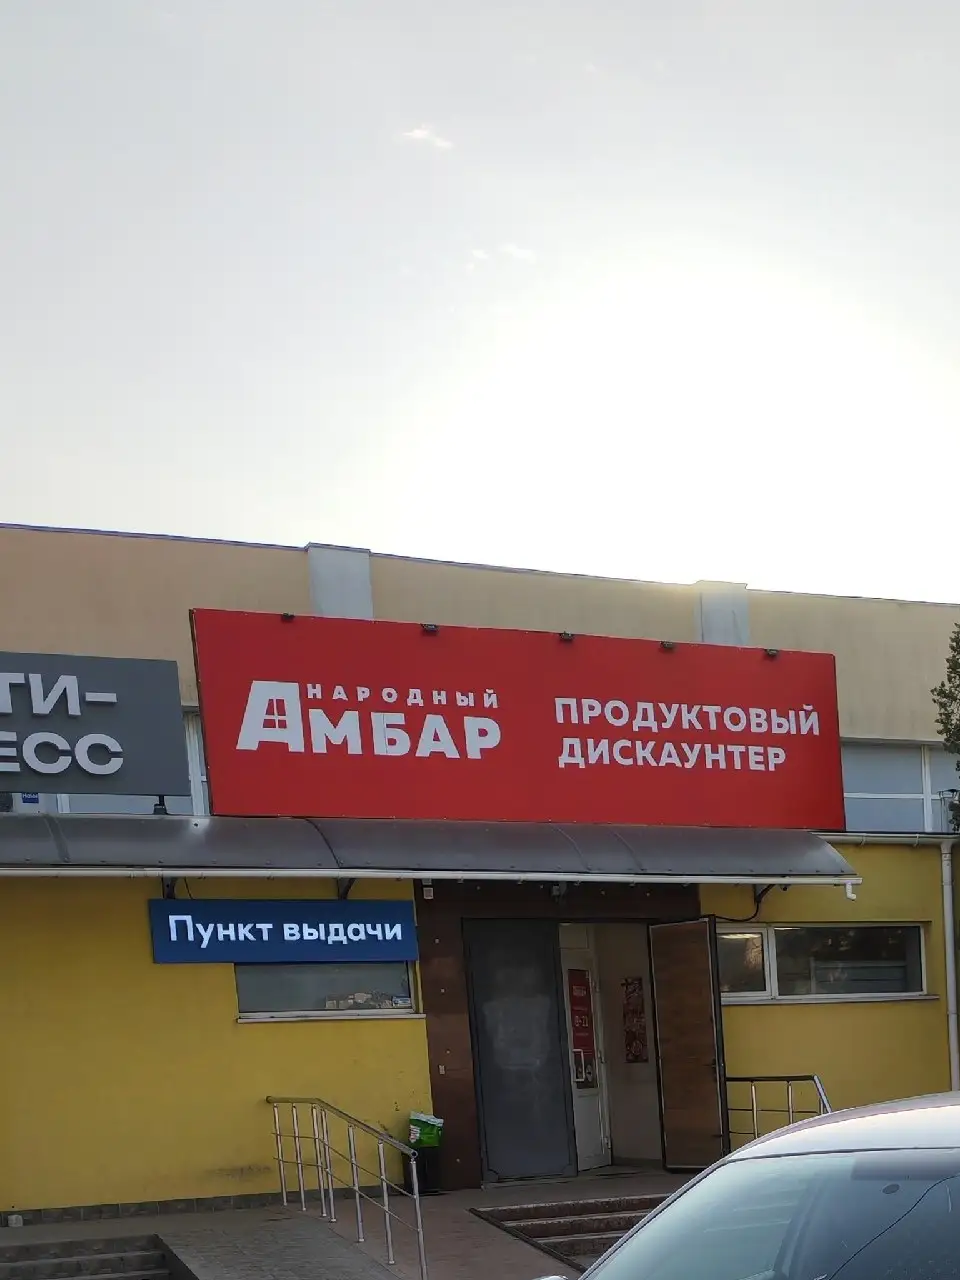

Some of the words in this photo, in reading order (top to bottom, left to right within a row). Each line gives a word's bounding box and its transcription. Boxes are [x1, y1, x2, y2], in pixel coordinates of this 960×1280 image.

[306, 683, 498, 709] НАРОДНЫЙ
[236, 680, 501, 760] АМБАР
[554, 697, 820, 736] ПРОДУКТОВЫЙ
[558, 737, 786, 771] ДИСКАУНТЕР
[168, 914, 273, 949] Пункт
[283, 922, 403, 945] выдачи
